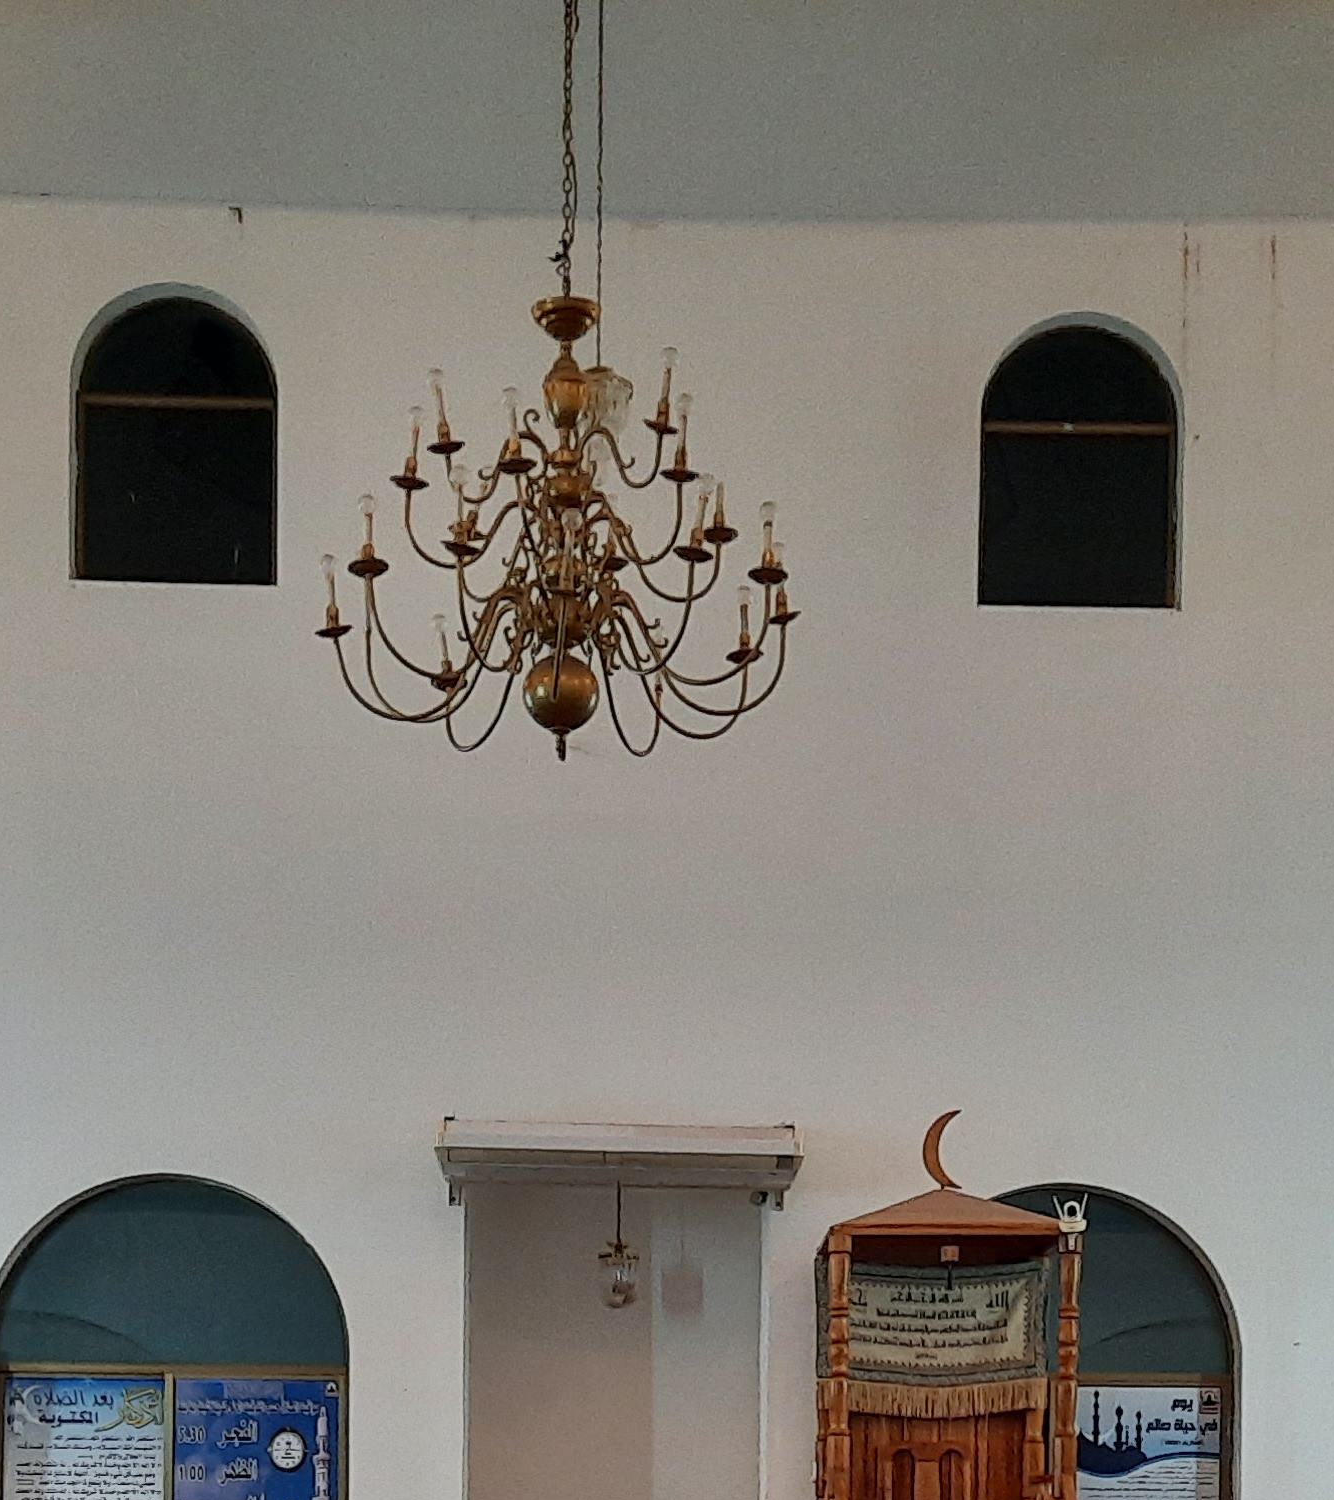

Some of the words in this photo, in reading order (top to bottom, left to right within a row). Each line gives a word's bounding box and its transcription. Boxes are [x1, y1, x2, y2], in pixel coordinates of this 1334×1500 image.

[93, 1393, 114, 1410] بعد
[1170, 1398, 1193, 1412] يوم
[38, 1409, 99, 1428] المكتوبة
[216, 1418, 258, 1449] الفجر
[217, 1457, 258, 1487] الظهر
